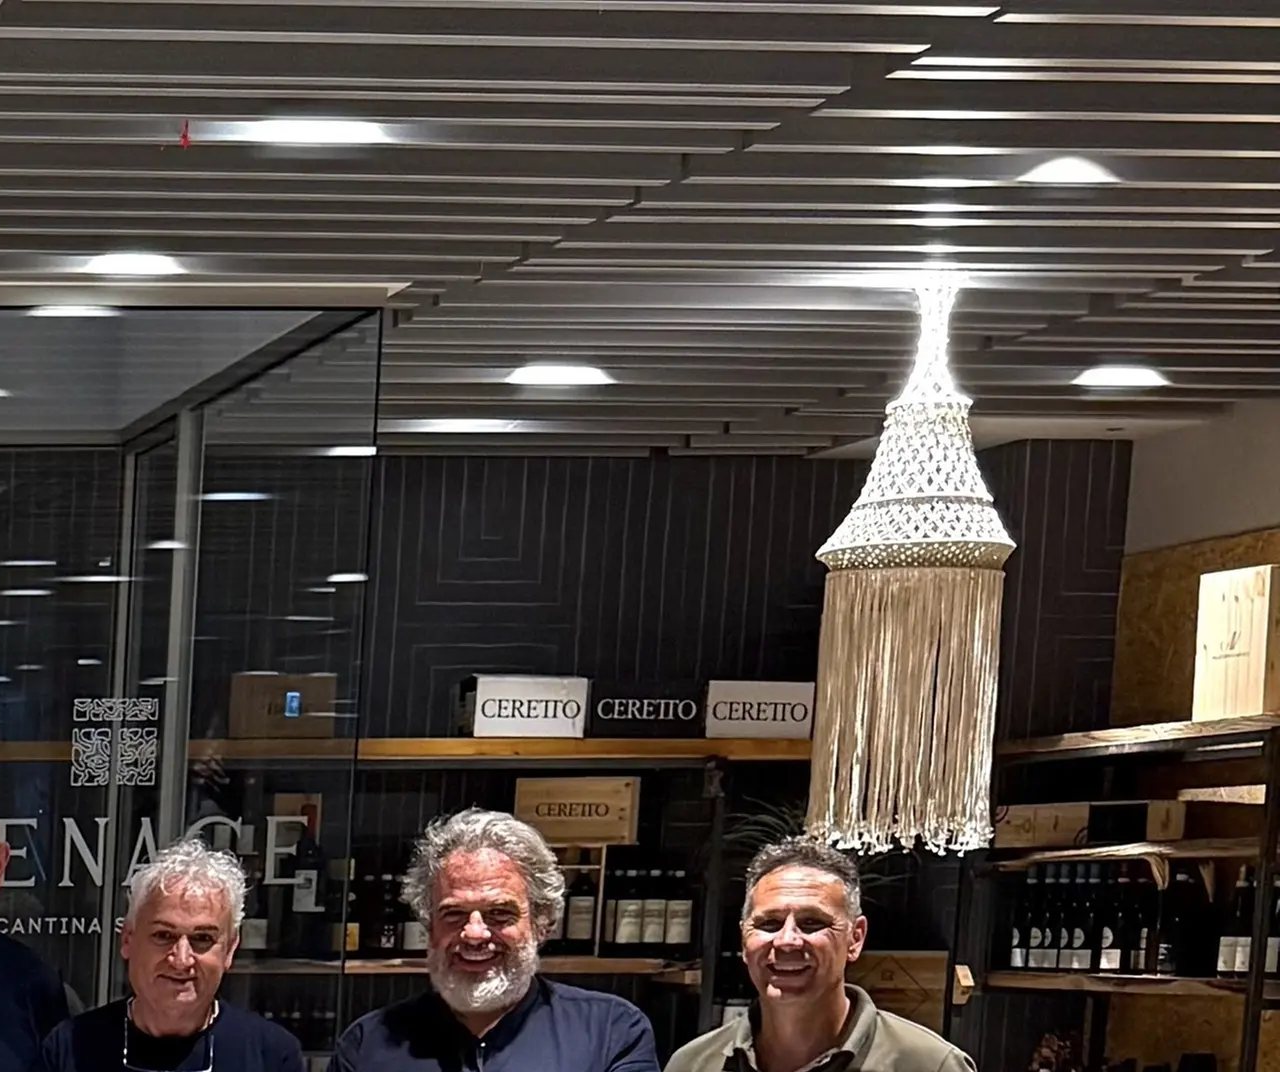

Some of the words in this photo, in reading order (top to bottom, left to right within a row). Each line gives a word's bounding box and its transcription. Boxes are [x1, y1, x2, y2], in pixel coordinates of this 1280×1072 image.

[480, 698, 581, 719] CERETTO
[596, 698, 697, 720] CERETTO
[712, 700, 808, 722] CERETTO
[535, 802, 610, 818] CERETTO
